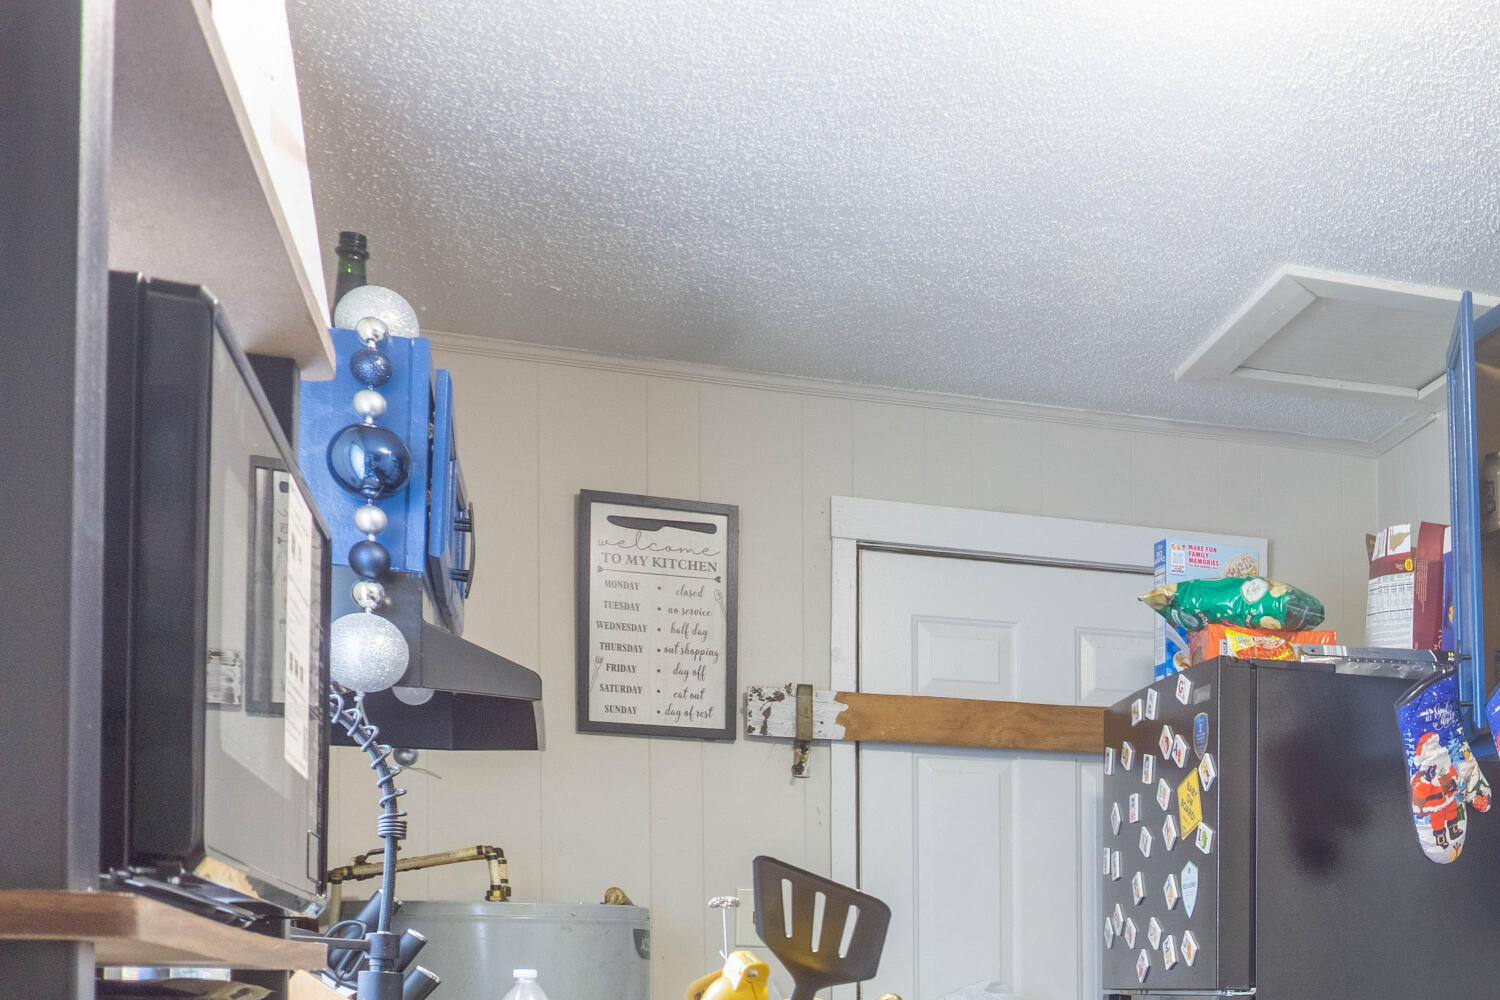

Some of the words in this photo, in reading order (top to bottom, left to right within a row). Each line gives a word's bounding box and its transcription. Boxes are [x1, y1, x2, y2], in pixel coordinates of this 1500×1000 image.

[597, 530, 720, 556] welcome
[1188, 544, 1204, 552] MAKE
[1205, 545, 1217, 553] FUN
[601, 552, 621, 564] TO
[625, 554, 648, 567] MY
[652, 557, 718, 573] KITCHEN
[1188, 551, 1209, 559] FAMILY
[1188, 557, 1220, 567] MEMORIES
[604, 579, 640, 591] MONDAY
[676, 584, 705, 598] closed
[603, 600, 641, 612] TUESDAY
[667, 607, 679, 616] no
[681, 606, 712, 617] service
[596, 620, 648, 633] WEDNESDAY
[670, 621, 690, 640] half
[691, 622, 708, 643] day
[600, 642, 643, 653] THURSDAY
[663, 642, 680, 654] out
[680, 642, 719, 665] shopping
[606, 663, 637, 673] FRIDAY
[672, 662, 689, 682] day
[692, 665, 706, 681] off
[599, 683, 643, 695] SATURDAY
[673, 687, 688, 699] eat
[690, 688, 706, 700] out
[604, 705, 638, 715] SUNDAY
[664, 703, 682, 723] day
[684, 705, 694, 721] of
[696, 706, 714, 719] rest
[1186, 782, 1198, 798] BABY
[1186, 794, 1194, 807] ON
